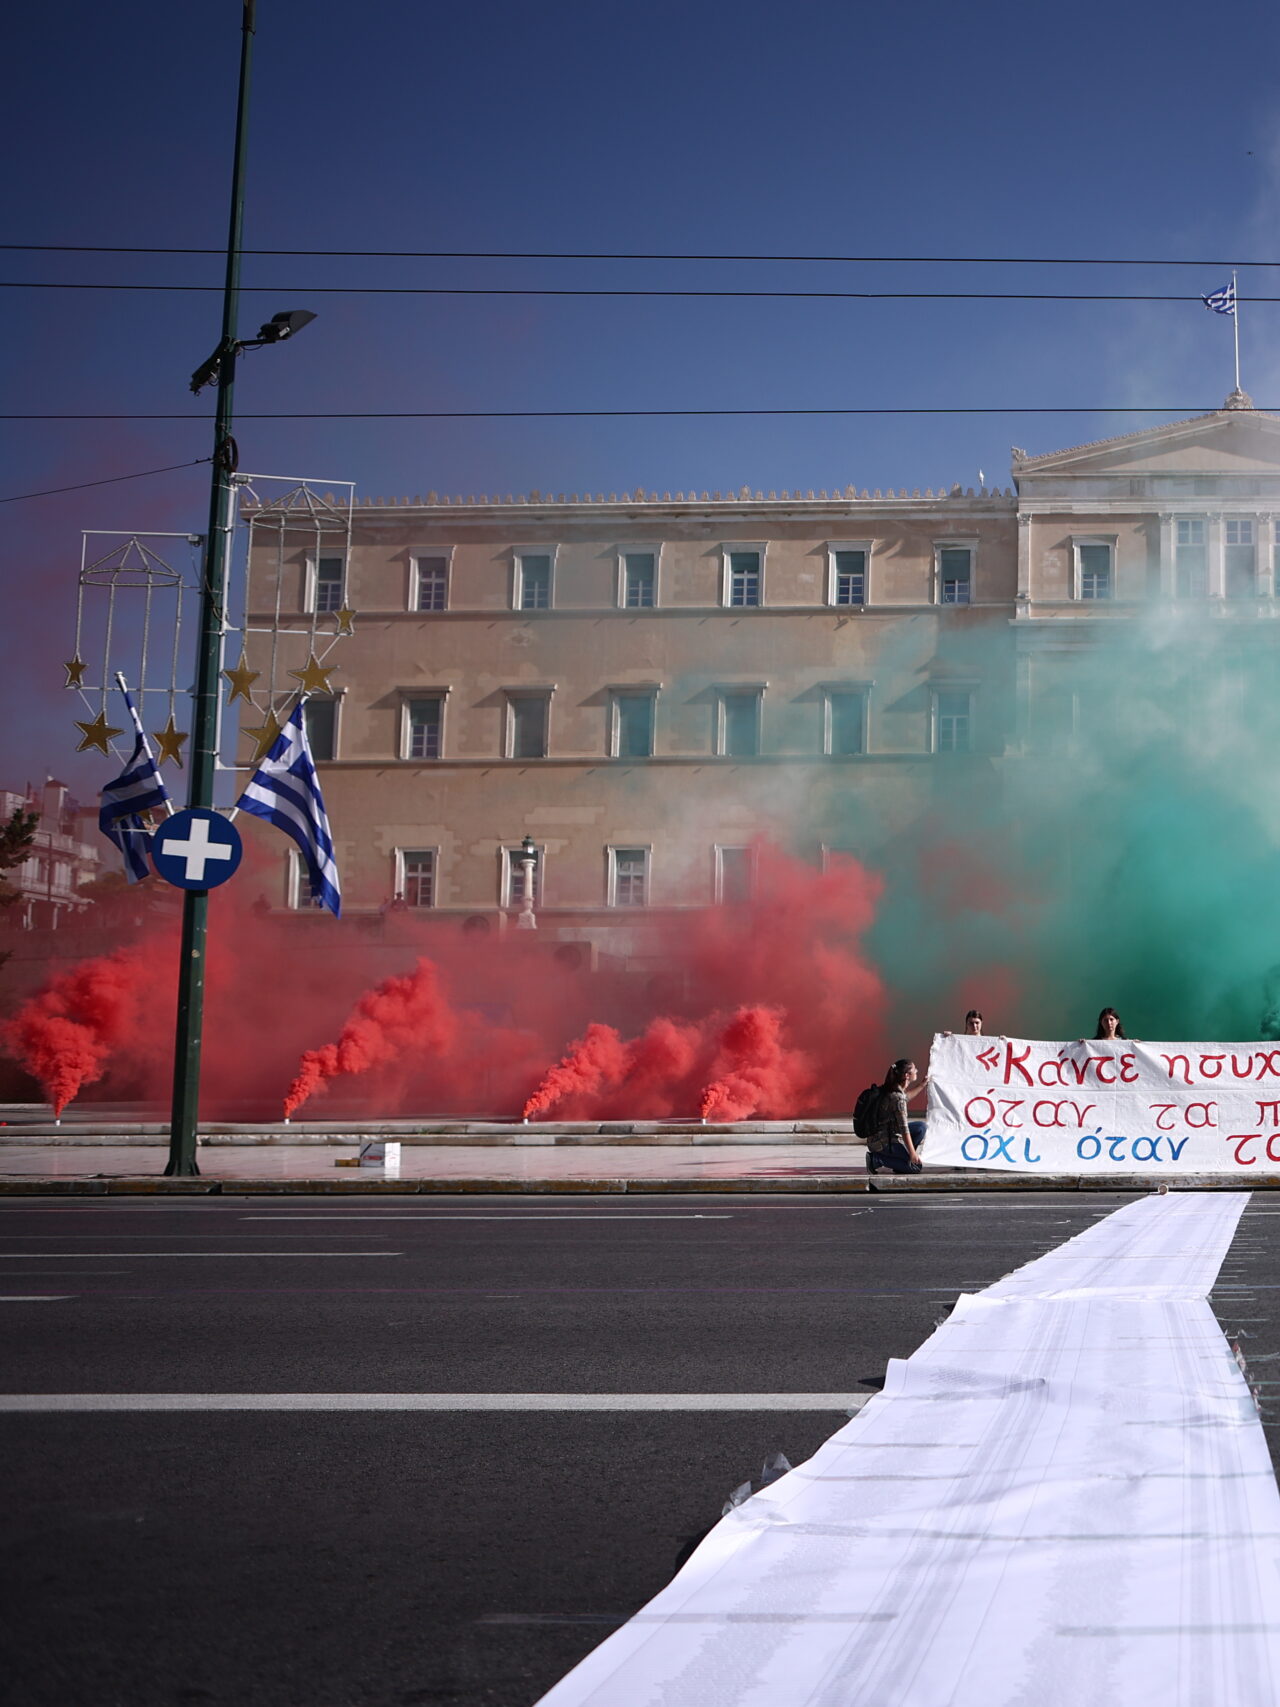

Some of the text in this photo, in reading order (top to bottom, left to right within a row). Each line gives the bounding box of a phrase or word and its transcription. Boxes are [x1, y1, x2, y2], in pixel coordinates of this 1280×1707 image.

[975, 1042, 1139, 1087] «Κάντε
[964, 1088, 1096, 1128] όταν
[1149, 1101, 1218, 1130] τα
[961, 1128, 1041, 1163] όχι
[1077, 1127, 1190, 1162] όταν
